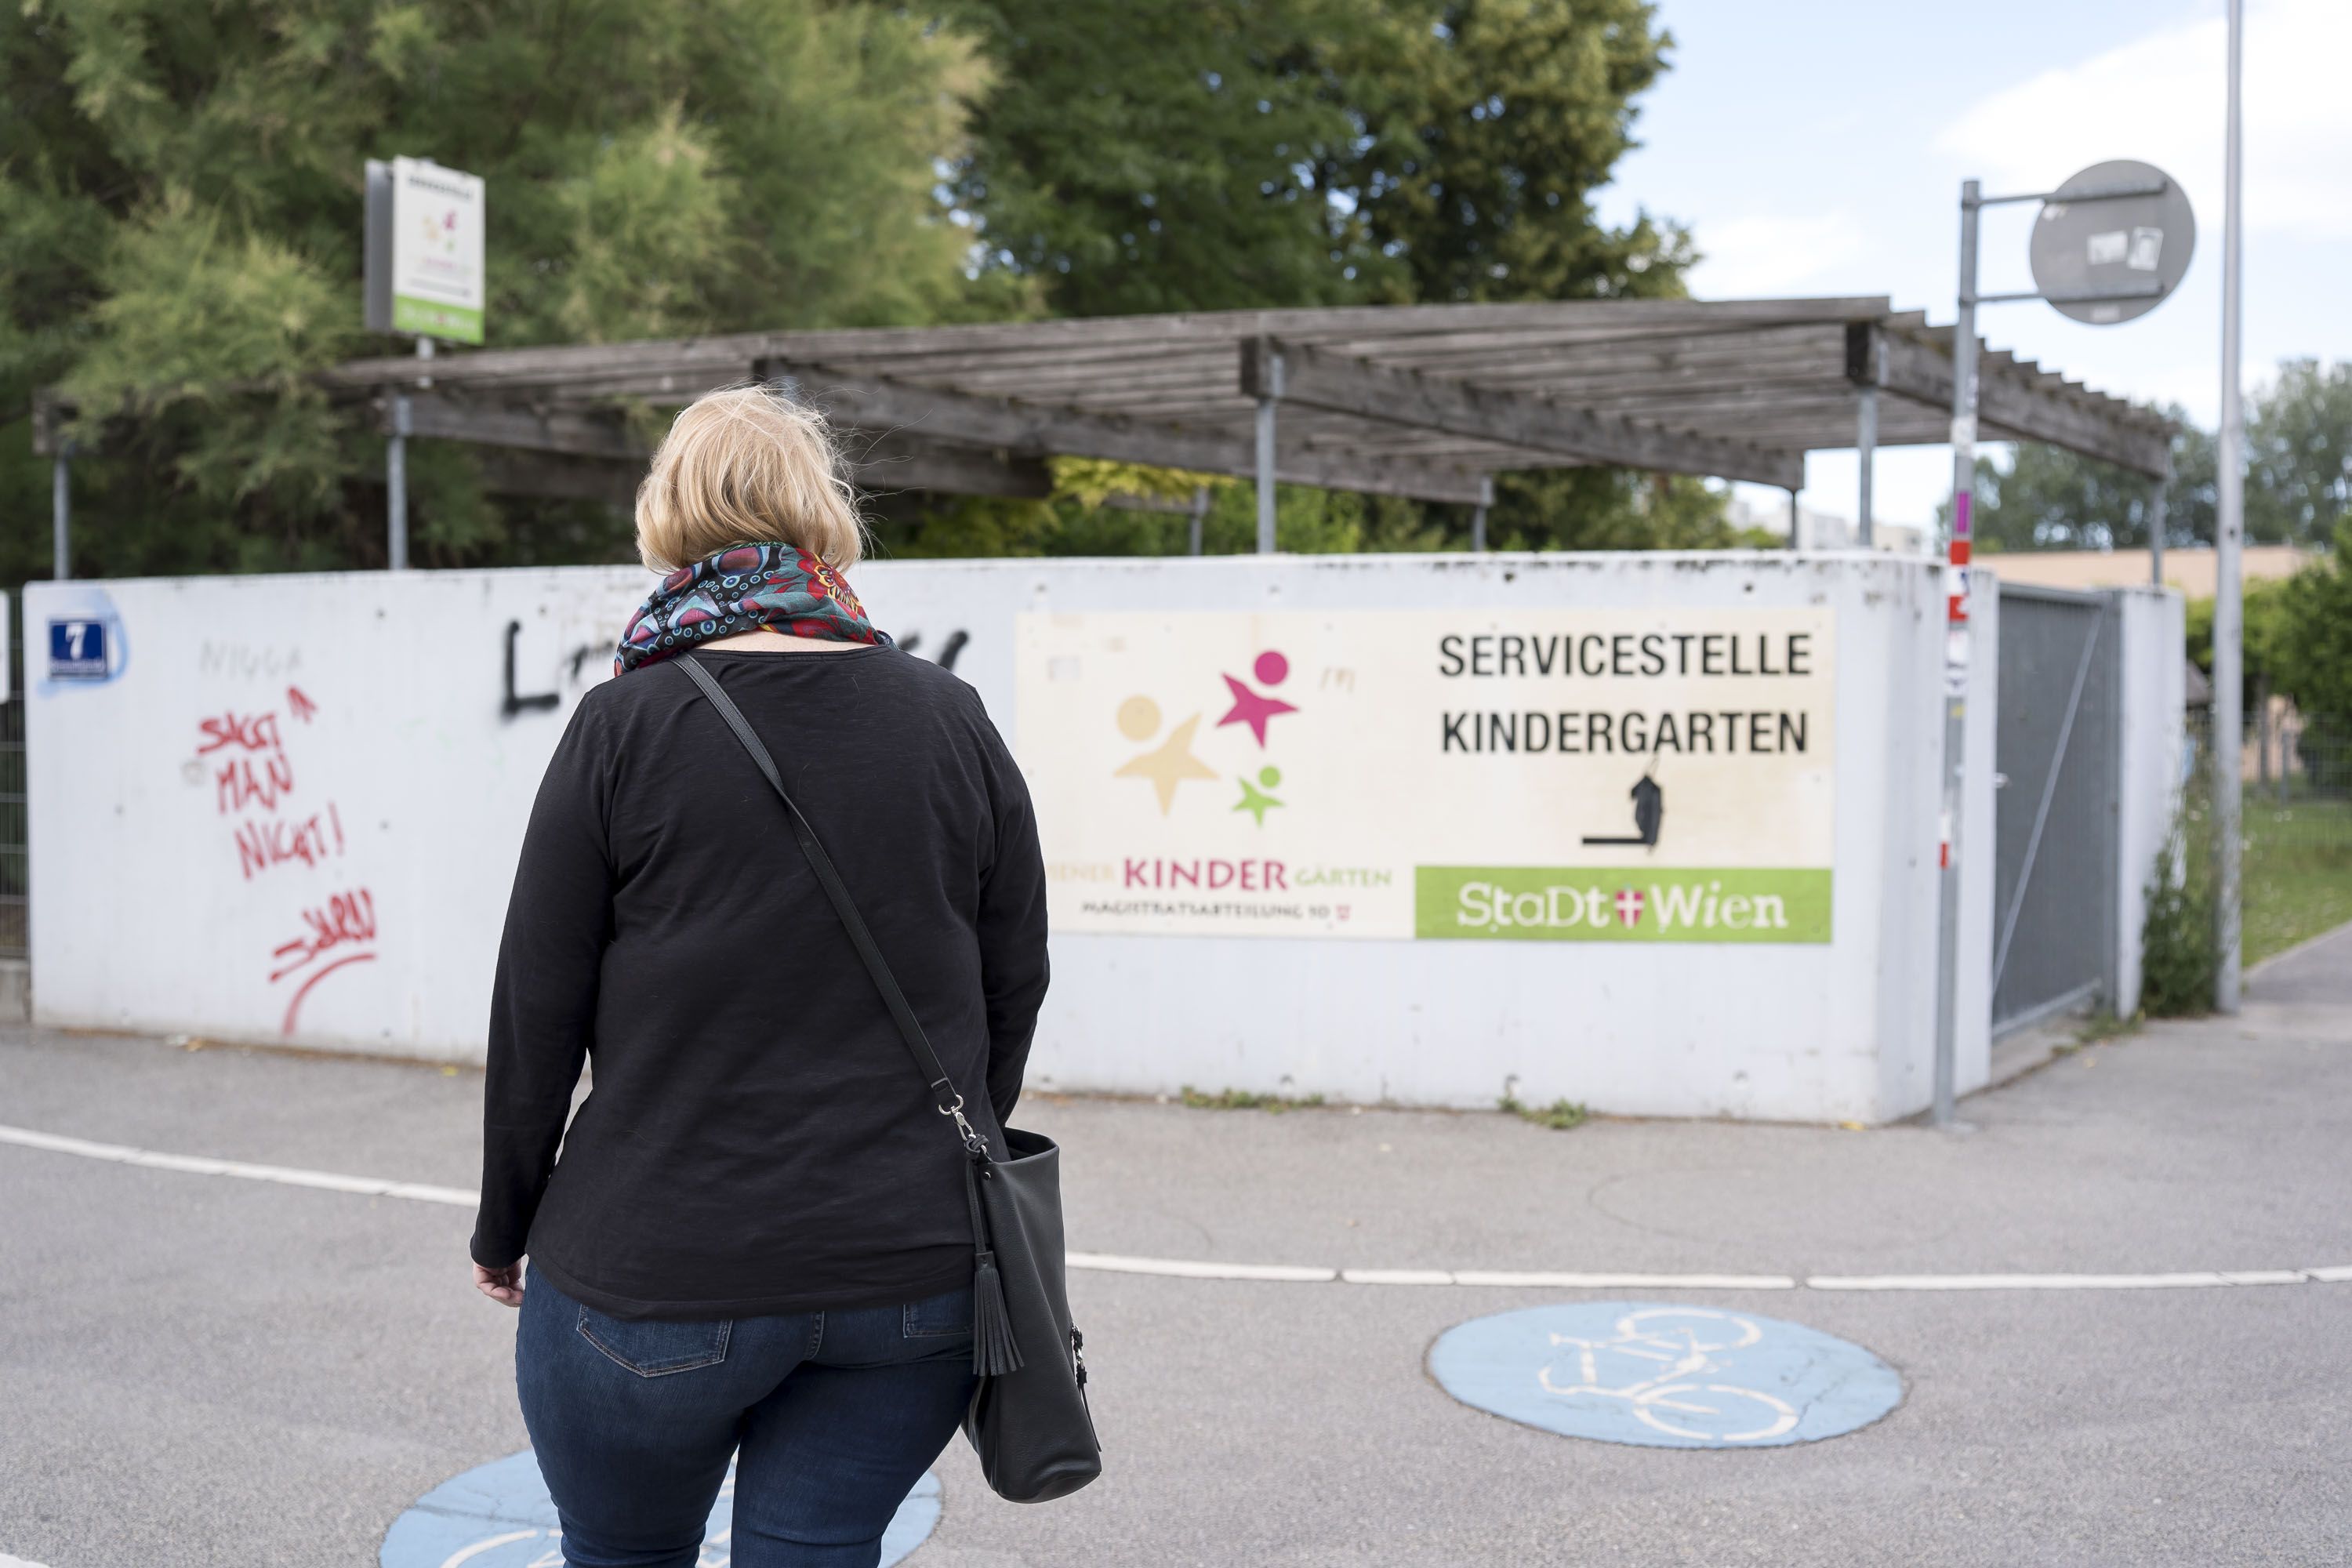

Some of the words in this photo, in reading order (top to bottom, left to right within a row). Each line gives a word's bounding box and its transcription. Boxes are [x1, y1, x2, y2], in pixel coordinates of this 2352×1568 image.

[65, 622, 88, 659] 7
[1439, 633, 1813, 677] SERVICESTELLE
[1440, 711, 1809, 753] KINDERGARTEN
[216, 757, 293, 815] MAN
[1123, 858, 1289, 891] KINDER
[1650, 880, 1788, 928] Wien
